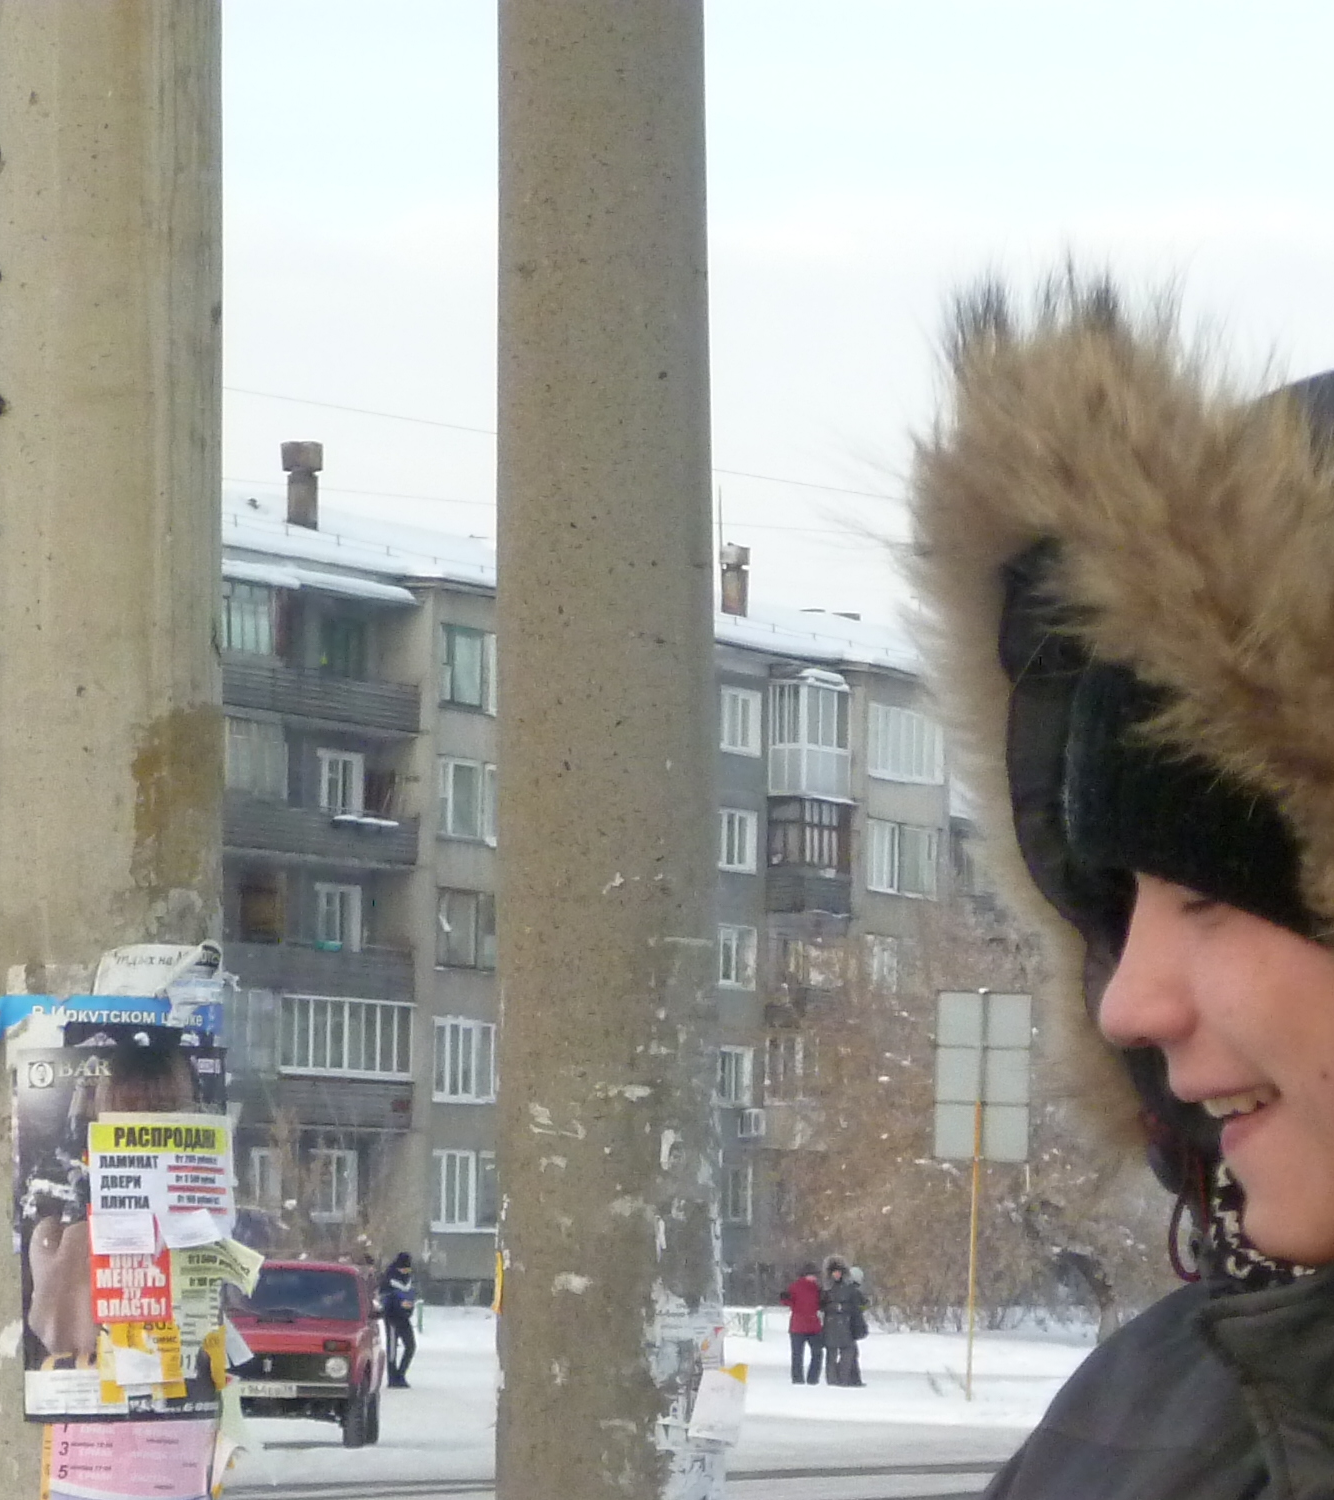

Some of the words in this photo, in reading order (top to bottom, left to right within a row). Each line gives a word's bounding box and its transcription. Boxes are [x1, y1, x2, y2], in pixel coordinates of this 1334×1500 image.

[99, 1155, 158, 1169] ЛАМИНАТ
[100, 1174, 141, 1190] ДВЕРИ
[101, 1195, 150, 1209] ПЛИТКА
[96, 1268, 165, 1288] МЕНЯТЬ
[59, 1441, 69, 1456] 3
[58, 1465, 68, 1479] 5
